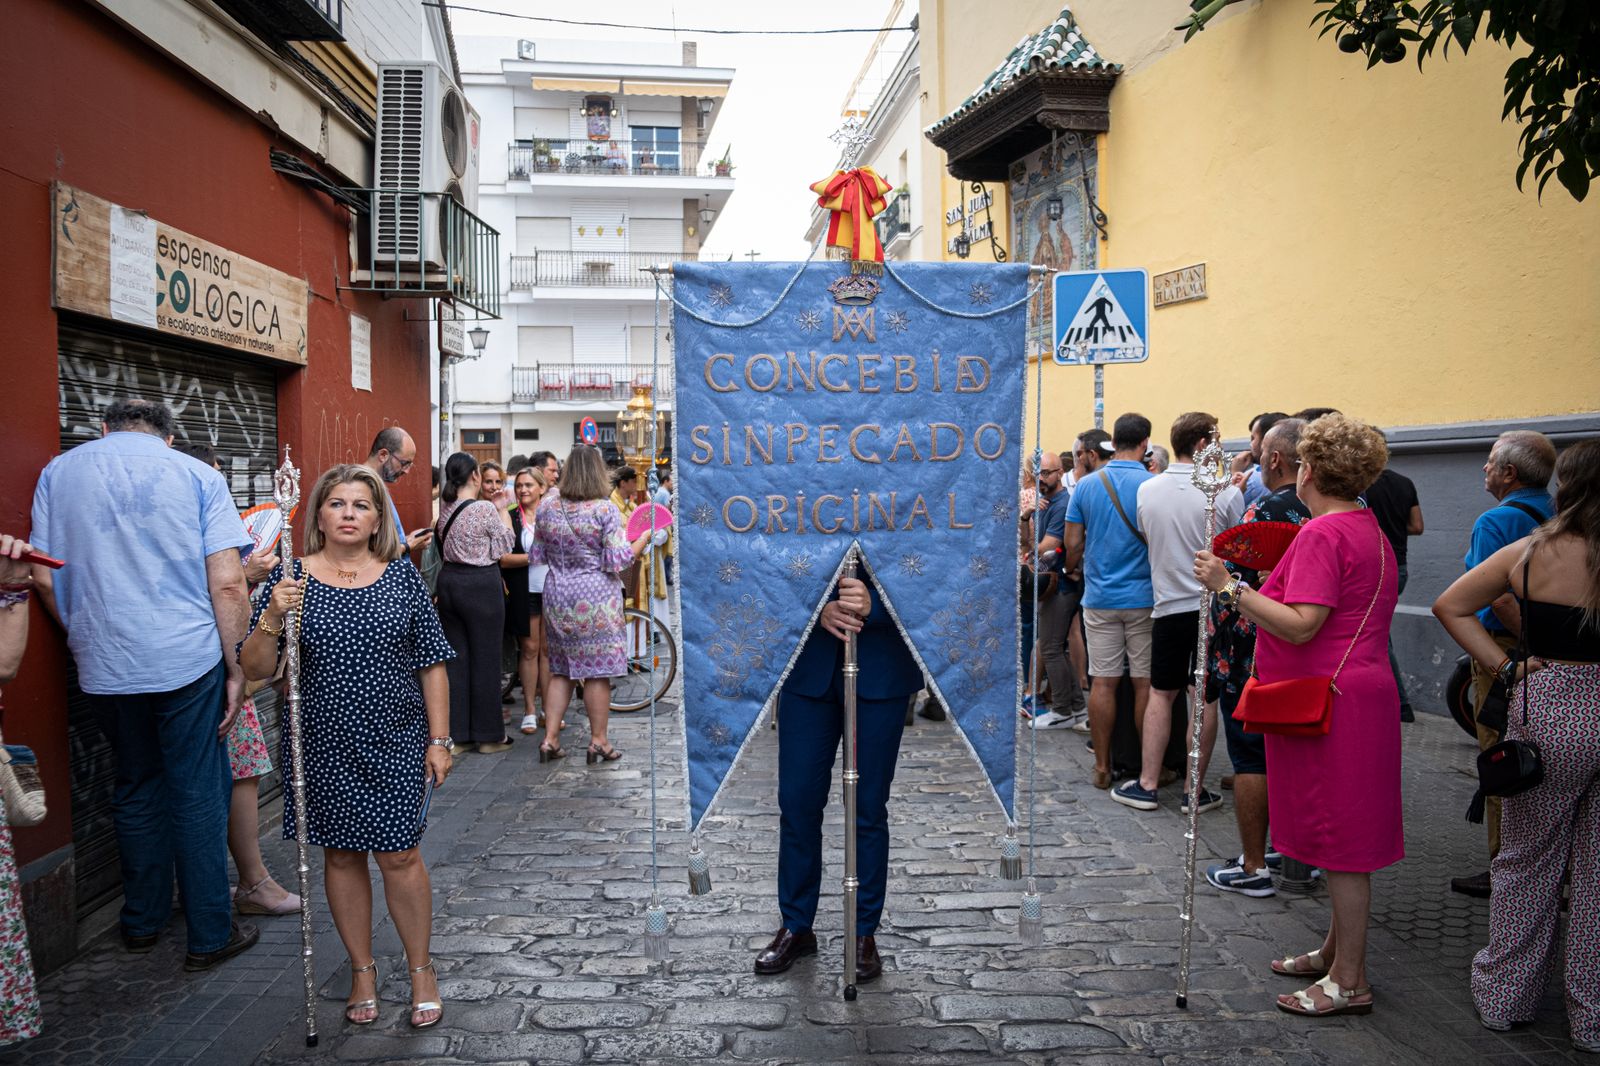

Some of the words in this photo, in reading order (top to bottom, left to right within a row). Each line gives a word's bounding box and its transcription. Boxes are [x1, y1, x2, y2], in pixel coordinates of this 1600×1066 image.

[210, 328, 242, 344] artesanos
[242, 336, 248, 348] y
[248, 338, 275, 352] naturales
[722, 488, 974, 535] ORIGINAL
